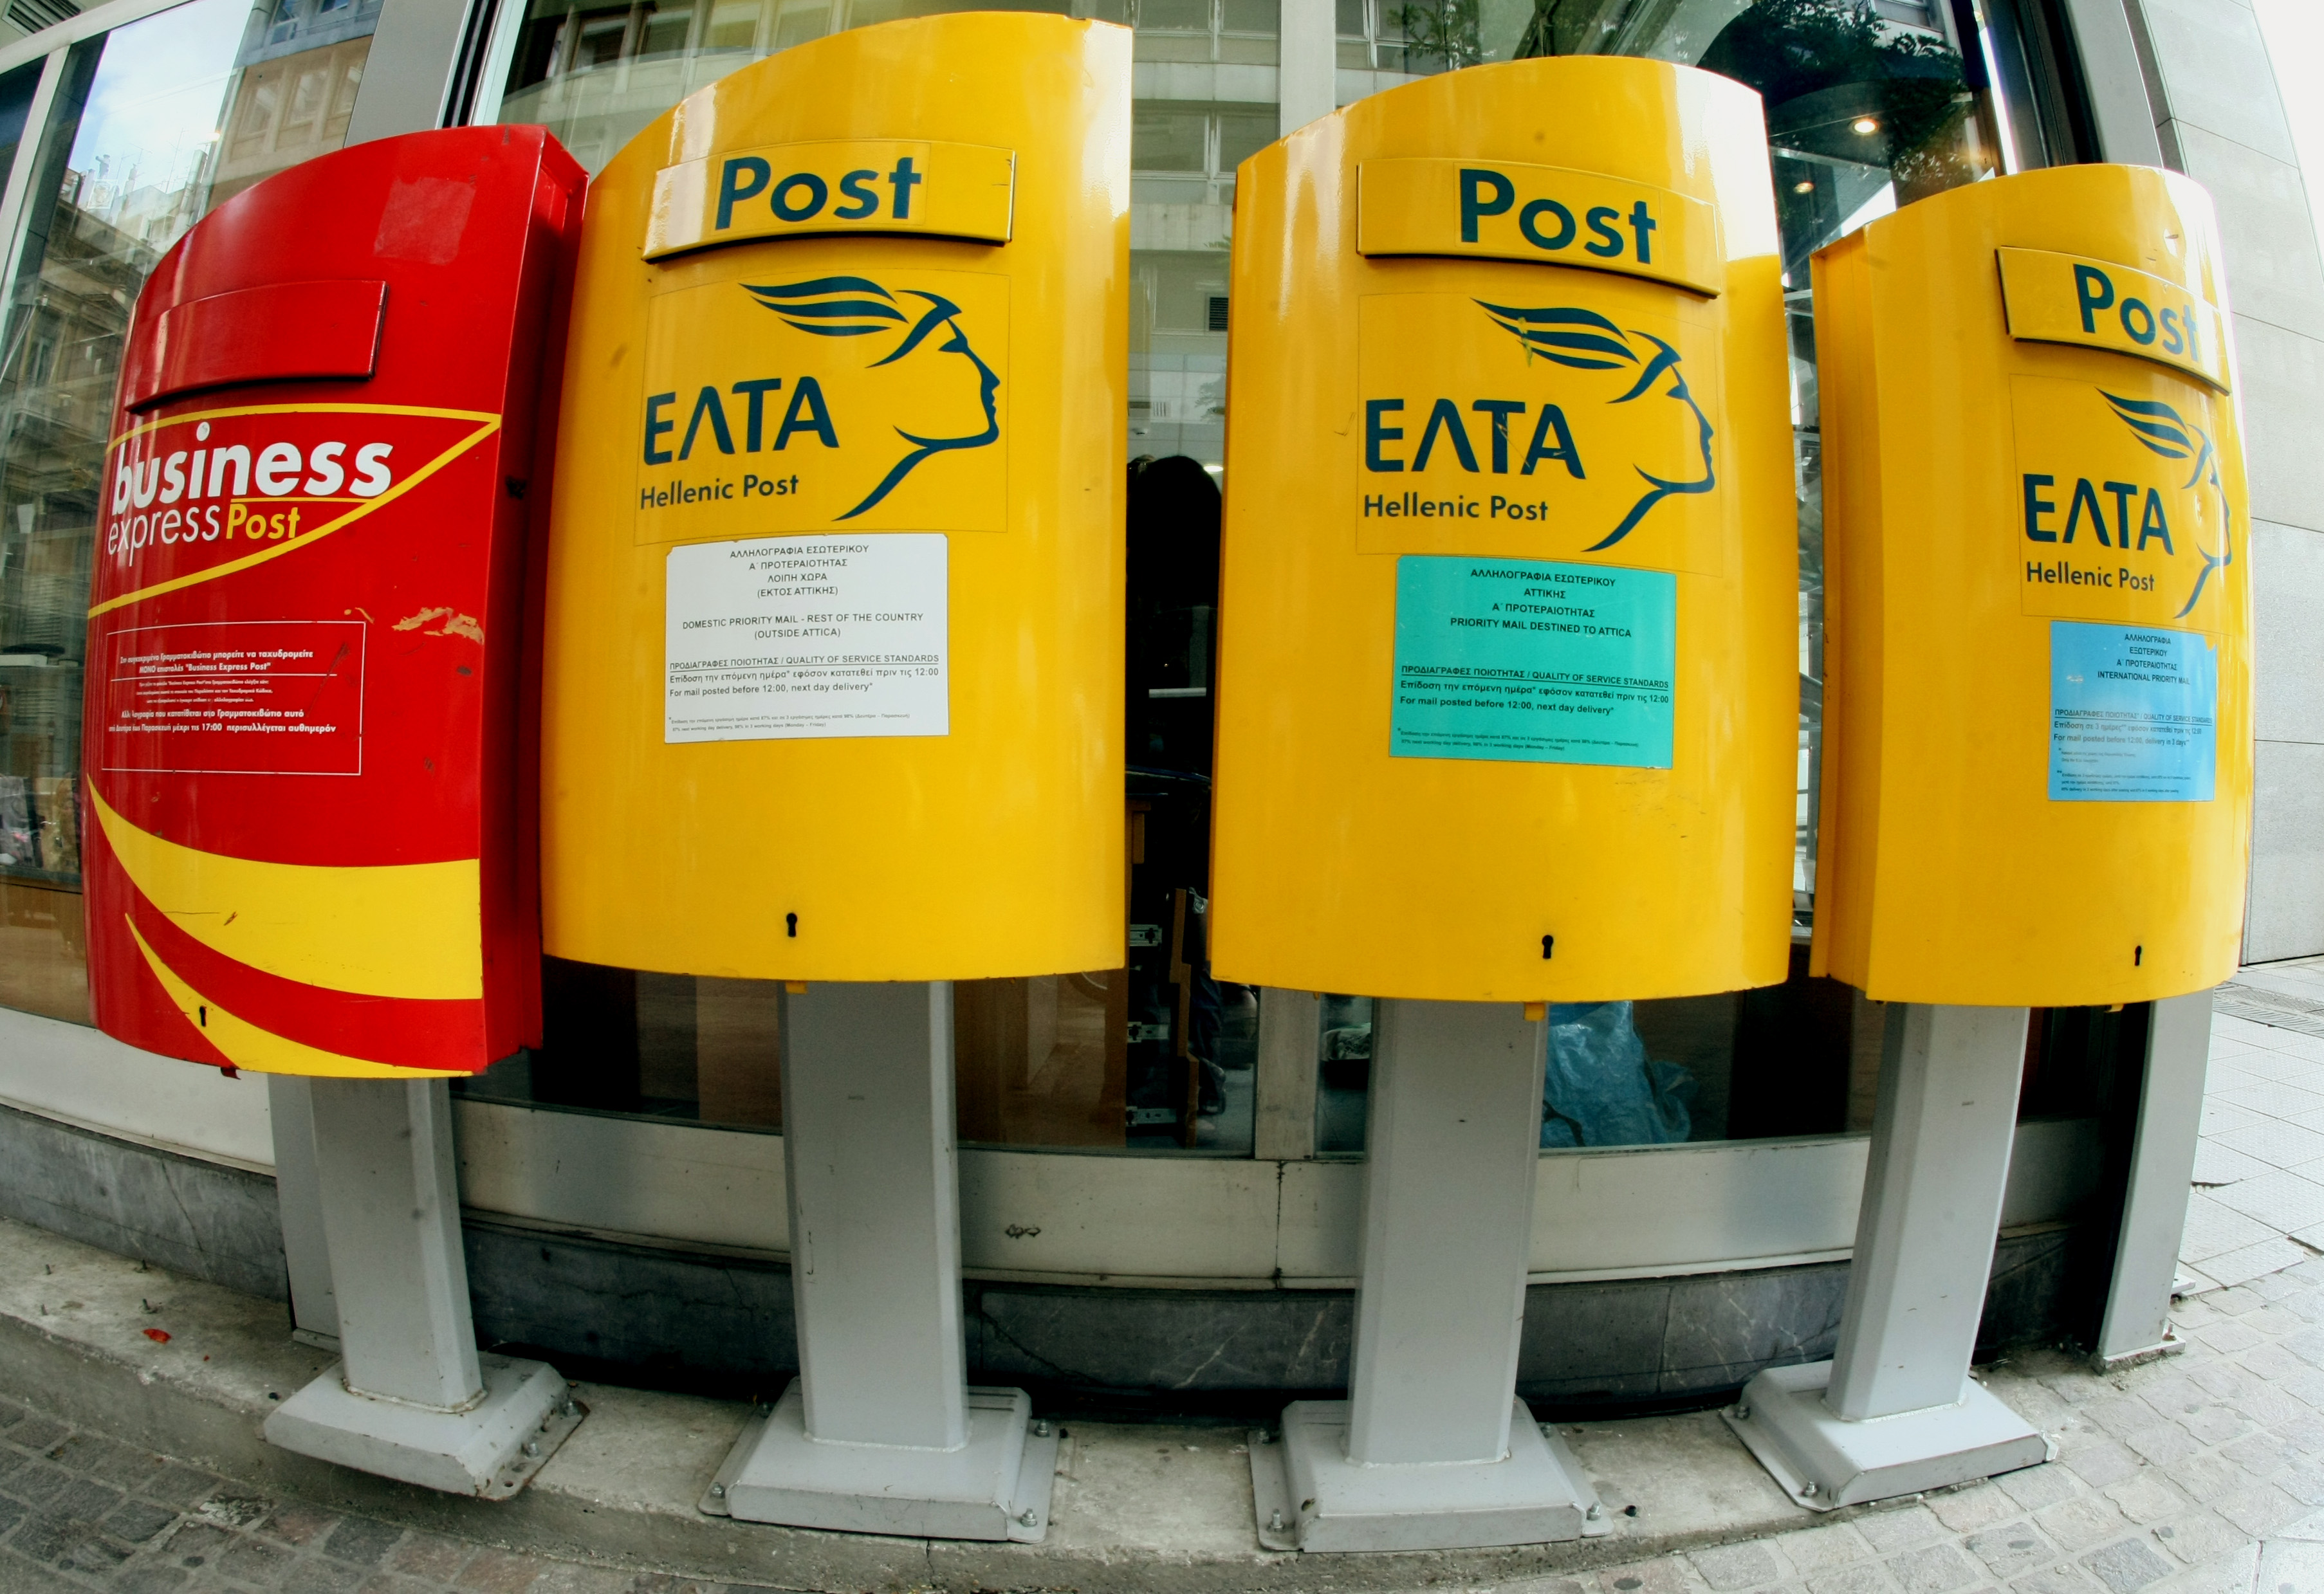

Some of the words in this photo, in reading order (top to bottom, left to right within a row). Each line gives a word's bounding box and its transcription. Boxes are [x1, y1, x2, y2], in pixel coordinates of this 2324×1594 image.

[715, 156, 921, 230] Post
[1459, 169, 1656, 264] Post
[2072, 263, 2199, 362] Post
[643, 376, 840, 465] ΕΛΤΑ
[1365, 398, 1587, 480] ΕΛΤΑ
[112, 422, 393, 516] business
[640, 478, 733, 509] Hellenic
[744, 474, 798, 498] Post
[1364, 492, 1479, 518] Hellenic
[1491, 495, 1548, 521] Post
[2023, 473, 2174, 556] ΕΛΤΑ
[108, 505, 220, 567] express
[226, 503, 300, 539] Post
[730, 546, 803, 558] ΑΛΛΗΛΟΓΡΑΦΙΑ
[807, 545, 869, 554] ΕΣΩΤΕΡΙΚΟΥ
[761, 559, 847, 569] ΠΡΟΤΕΡΑΙΟΤΗΤΑΣ
[768, 574, 797, 583] ΛΟΙΠΗ
[1471, 569, 1551, 582] ΑΛΛΗΛΟΓΡΑΦΙΑ
[1555, 574, 1615, 587] ΕΣΩΤΕΡΙΚΟΥ
[2027, 561, 2112, 587] Hellenic
[2119, 567, 2155, 591] Post
[1524, 589, 1565, 598] ΑΤΤΙΚΗΣ
[1506, 604, 1595, 618] ΠΡΟΤΕΡΑΙΟΤΗΤΑΣ
[683, 619, 726, 629] DOMESTIC
[730, 617, 773, 626] PRIORITY
[807, 614, 833, 623] REST
[876, 613, 923, 621] COUNTRY
[1451, 618, 1499, 628] PRIORITY
[1502, 620, 1527, 630] MAIL
[1531, 622, 1580, 633] DESTINED
[1583, 626, 1596, 634] TO
[1599, 627, 1631, 637] ATTICA
[755, 630, 799, 640] (OUTSIDE
[802, 628, 841, 638] ATTICA)
[2125, 634, 2171, 644] ΑΛΛΗΛΟΓΡΑΦΙΑ
[259, 649, 313, 659] ταχυδρομείτε
[2130, 646, 2168, 657] ΕΞΩΤΕΡΙΚΟΥ
[219, 663, 248, 672] Express
[670, 660, 728, 670] ΠΡΟΔΙΑΓΡΑΦΕΣ
[731, 657, 779, 666] ΠΟΙΟΤΗΤΑΣ
[786, 655, 824, 665] QUALITY
[884, 654, 939, 663] STANDARDS
[706, 674, 719, 682] την
[916, 668, 939, 676] 12:00
[1402, 666, 1471, 675] ΠΡΟΔΙΑΓΡΑΦΕΣ
[1474, 668, 1524, 678] ΠΟΙΟΤΗΤΑΣ
[1533, 671, 1570, 681] QUALITY
[1586, 675, 1621, 684] SERVICE
[1624, 677, 1668, 688] STANDARDS
[2098, 671, 2150, 681] INTERNATIONAL
[2152, 675, 2177, 683] PRIORITY
[685, 688, 700, 696] mail
[703, 686, 730, 697] posted
[733, 685, 759, 694] before
[762, 684, 789, 694] 12:00,
[791, 684, 810, 692] next
[813, 682, 829, 694] day
[1417, 697, 1437, 706] mail
[1440, 698, 1471, 708] posted
[1475, 699, 1504, 708] before
[1508, 701, 1533, 710] 12:00,
[1559, 704, 1574, 713] day
[1650, 694, 1668, 703] 12:00
[288, 724, 336, 734] αυθημερόν
